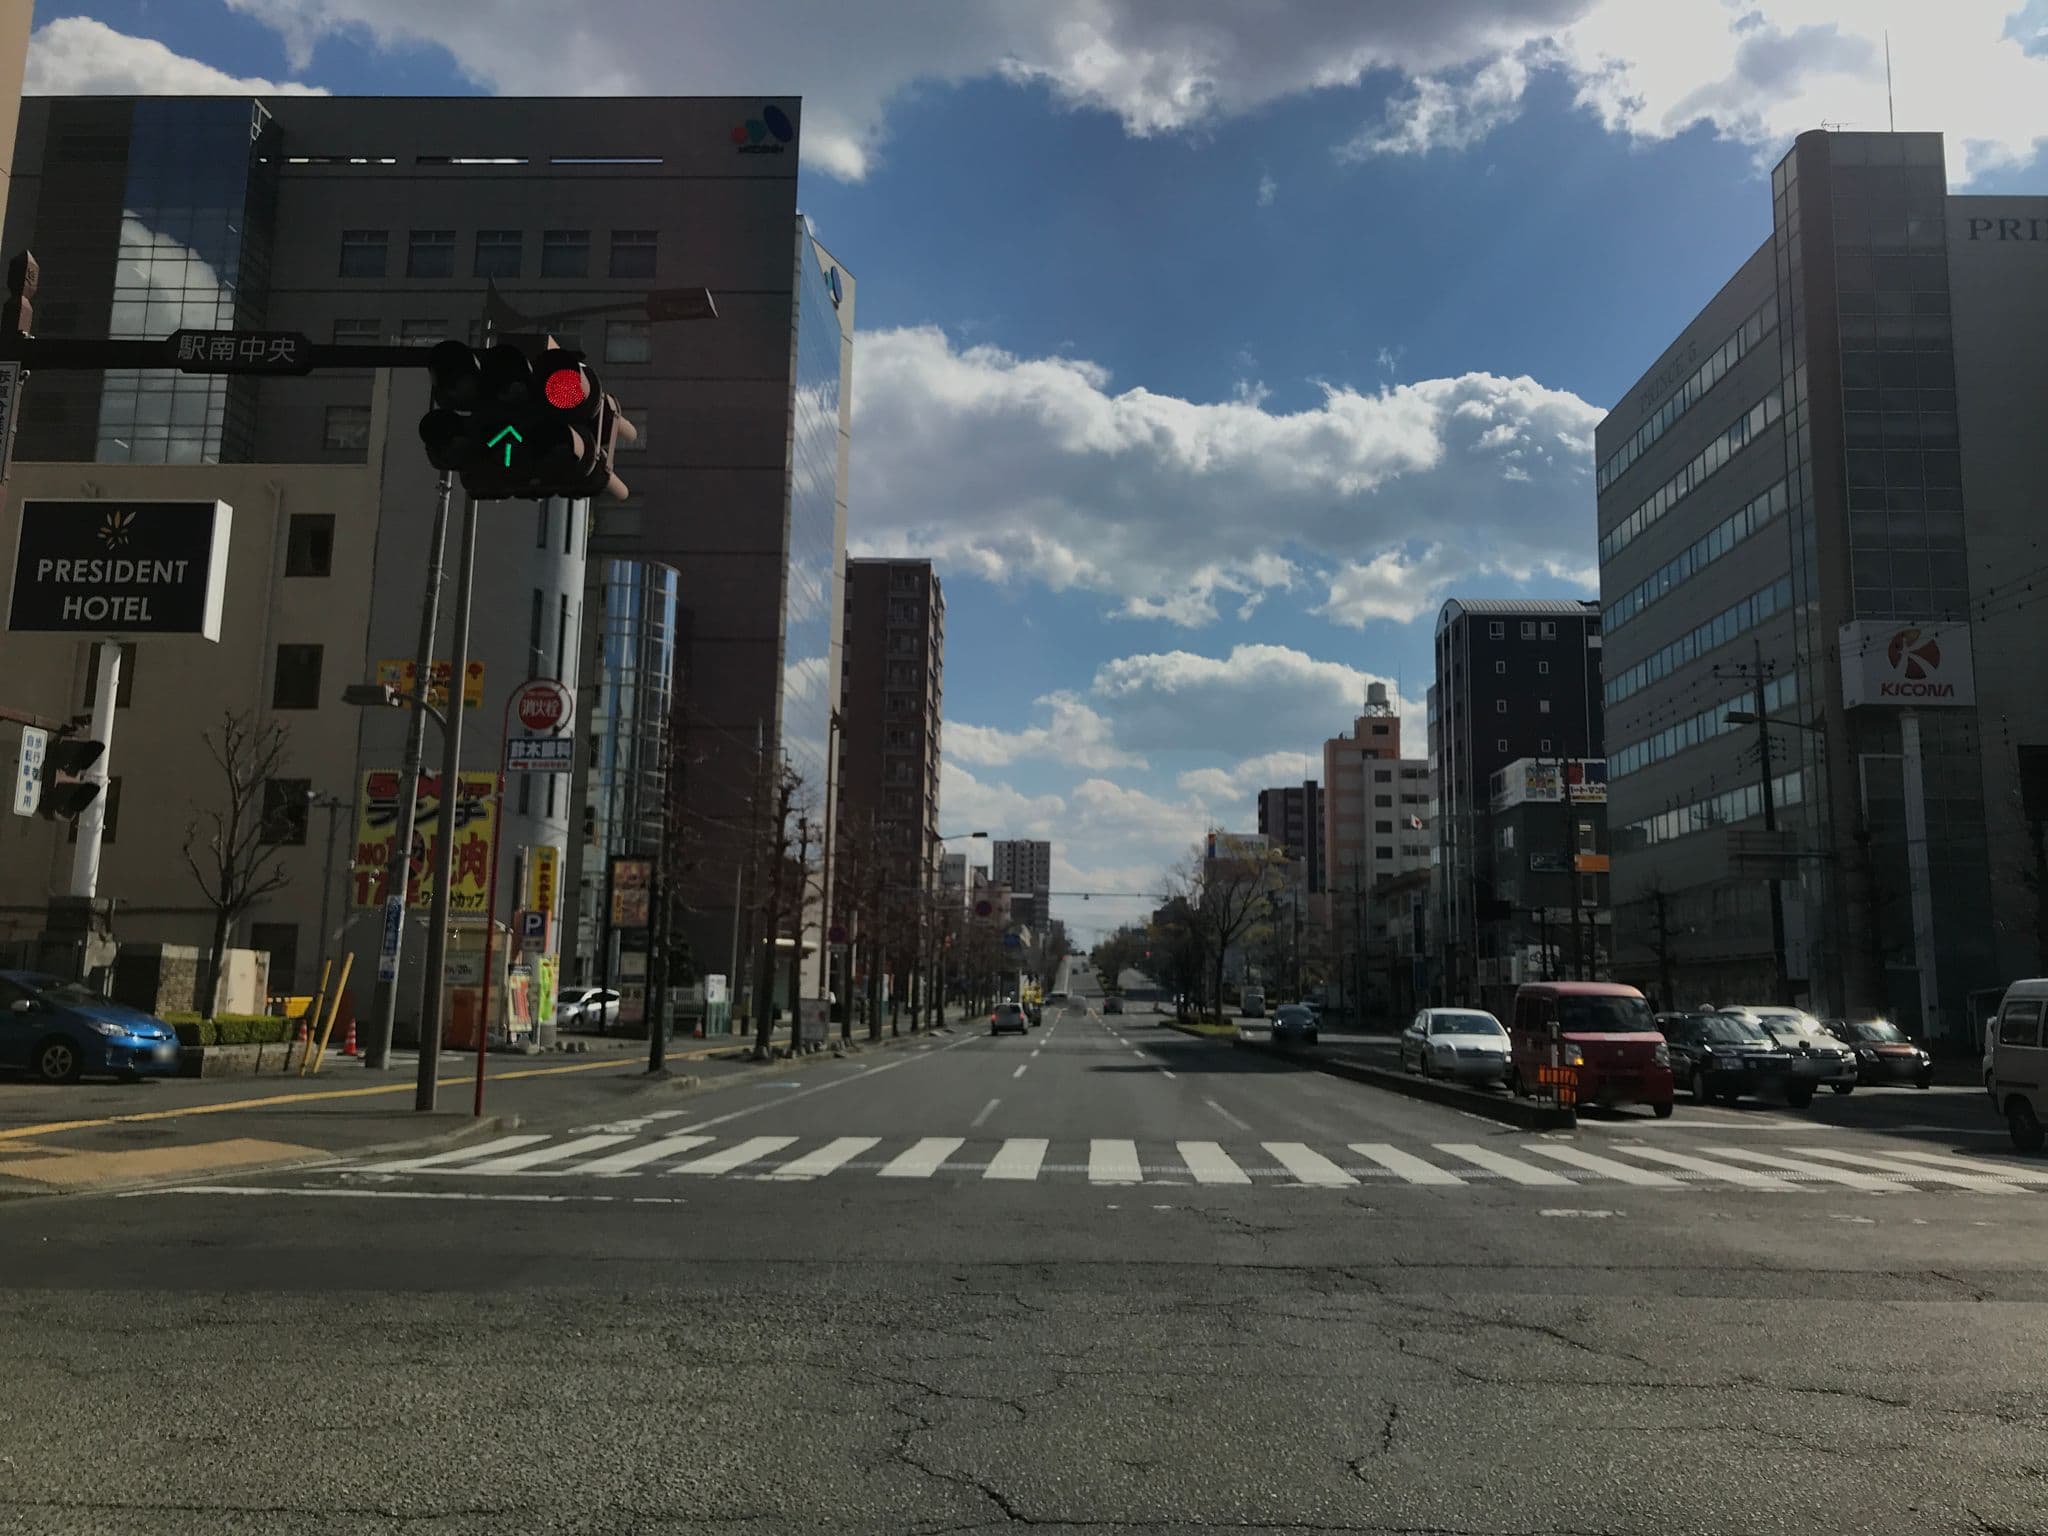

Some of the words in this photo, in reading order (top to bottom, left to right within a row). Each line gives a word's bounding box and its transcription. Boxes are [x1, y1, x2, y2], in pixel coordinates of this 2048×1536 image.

[1968, 218, 2048, 241] PRI
[178, 335, 296, 363] 駅南中央
[37, 558, 189, 584] PRESIDENT
[62, 595, 152, 622] HOTEL
[521, 699, 561, 717] 消火栓
[525, 914, 544, 934] P
